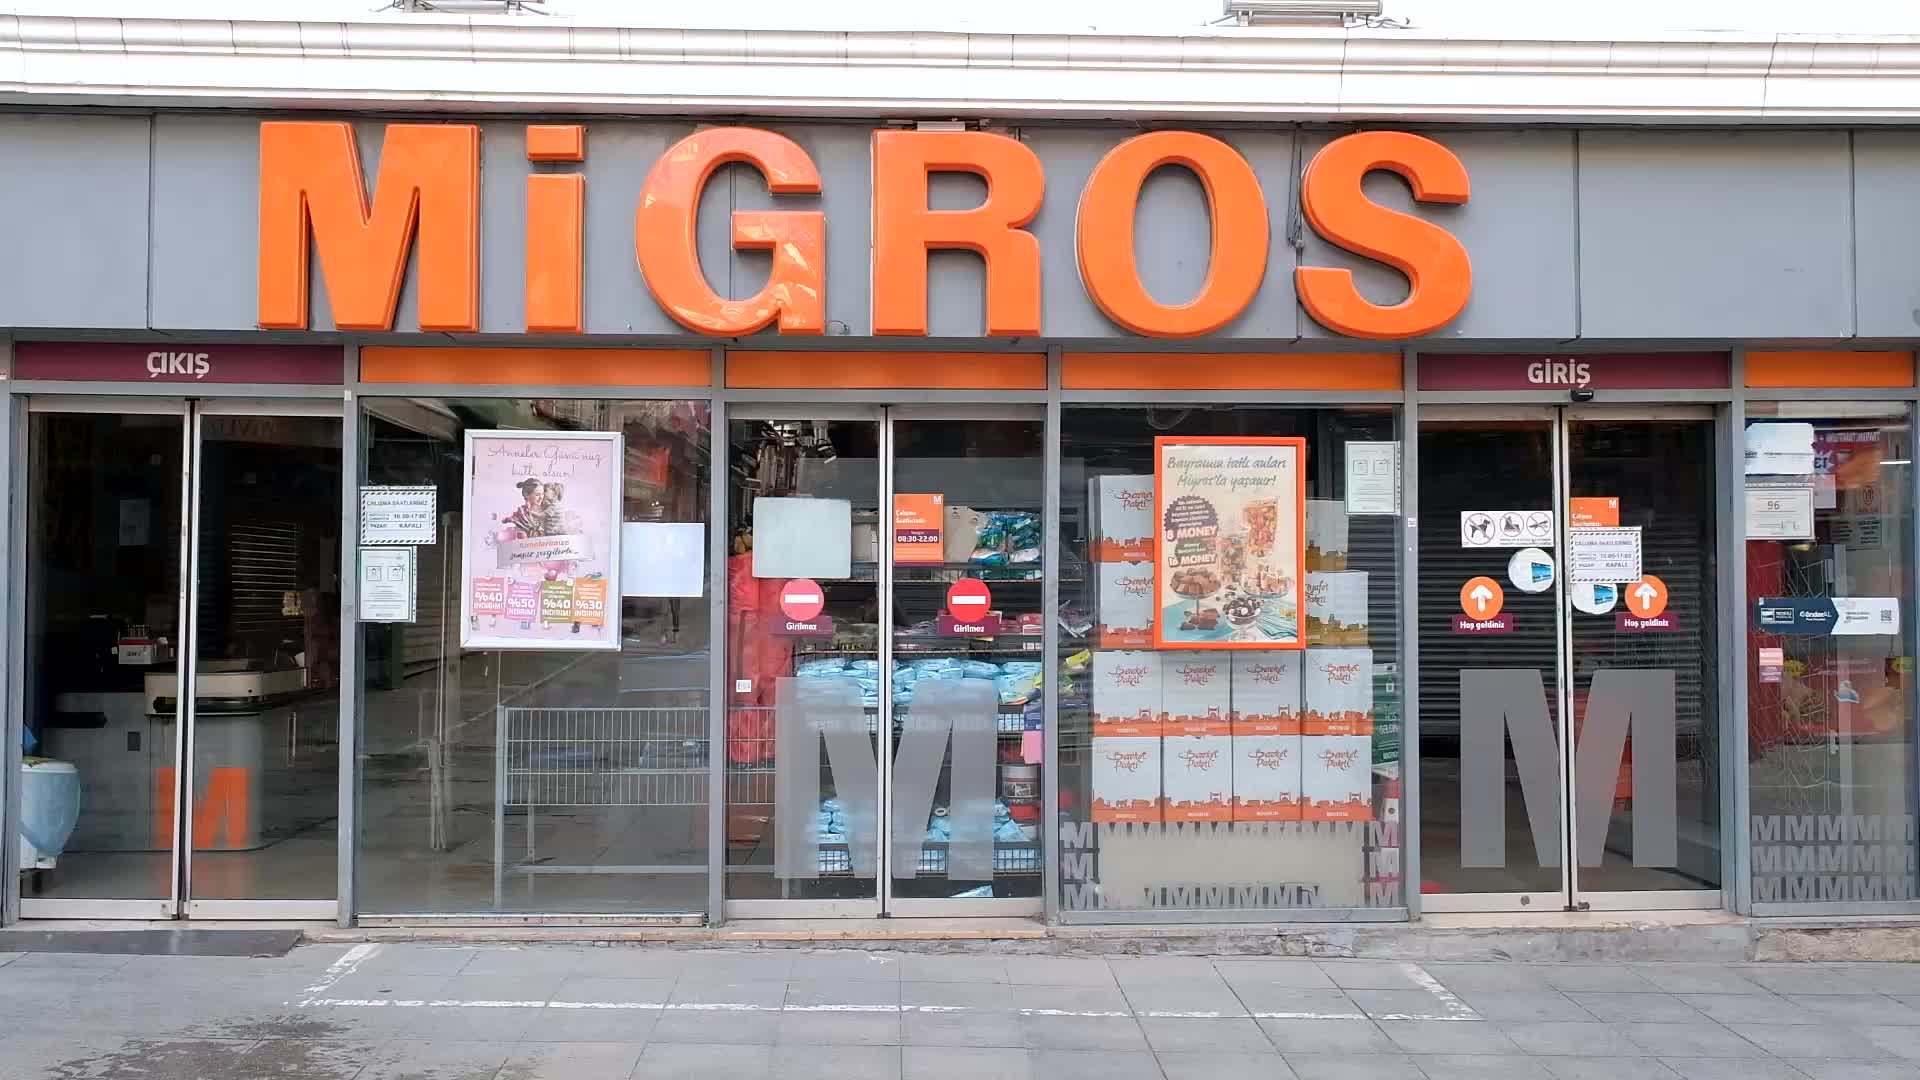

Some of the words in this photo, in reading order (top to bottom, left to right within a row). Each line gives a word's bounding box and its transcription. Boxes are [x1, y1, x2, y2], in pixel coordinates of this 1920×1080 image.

[146, 351, 210, 379] ÇIKIŞ
[1527, 358, 1591, 389] GİRİŞ
[1177, 525, 1218, 538] MONEY
[1181, 553, 1217, 565] MONEY
[474, 592, 503, 601] %40
[508, 598, 536, 608] %50
[543, 599, 571, 609] %40
[575, 600, 603, 610] %30
[786, 622, 817, 631] Girilmez
[953, 624, 985, 633] Girilmez
[1459, 620, 1475, 630] Hoş
[1476, 620, 1505, 631] geldiniz
[1624, 618, 1639, 629] Hoş
[1640, 618, 1669, 628] geldiniz
